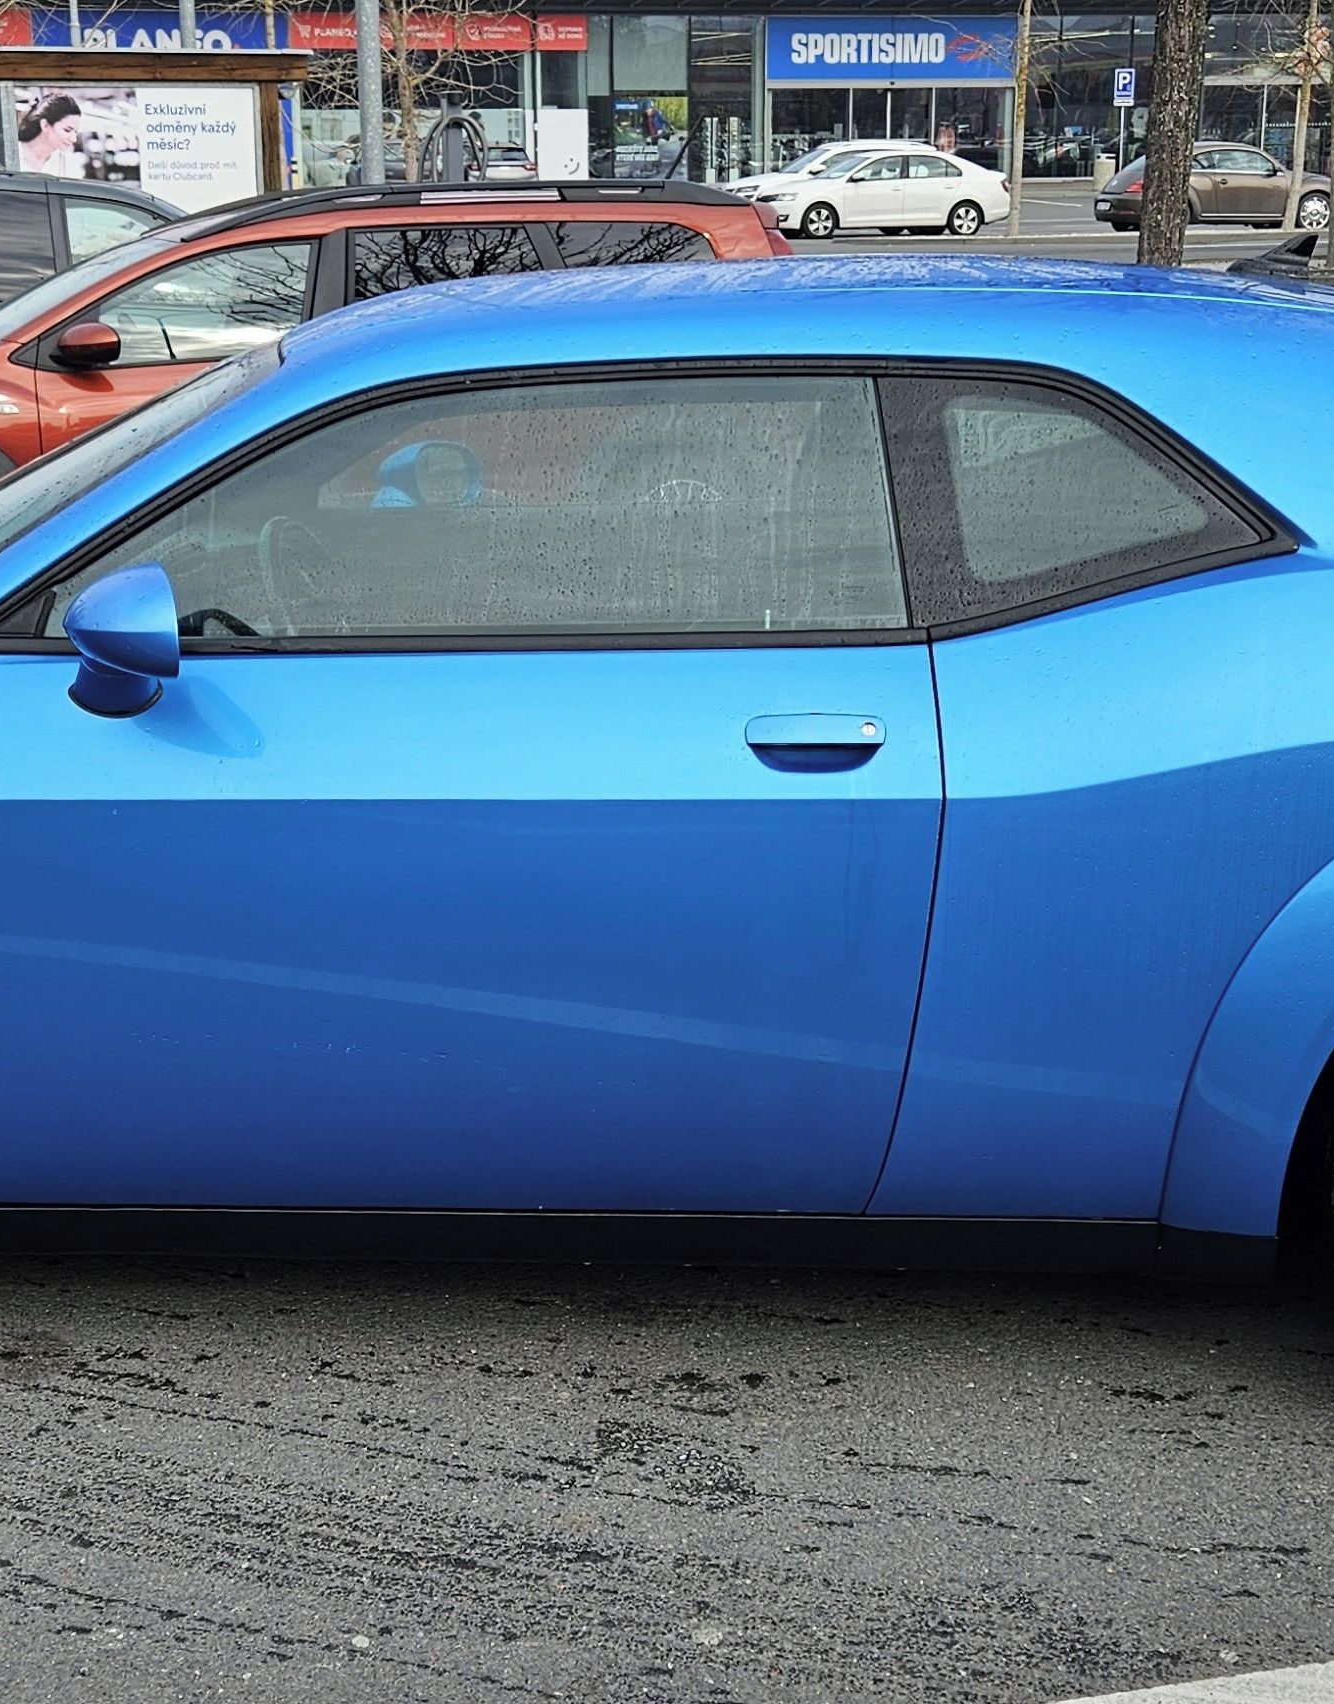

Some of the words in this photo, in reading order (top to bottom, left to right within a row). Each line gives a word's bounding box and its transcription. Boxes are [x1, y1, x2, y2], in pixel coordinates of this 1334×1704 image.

[791, 33, 946, 64] SPORTISIMO
[1119, 72, 1131, 90] P
[145, 103, 206, 116] Exkluzivní
[146, 121, 197, 136] odměny
[201, 121, 237, 136] každý
[147, 138, 191, 151] měsíc?
